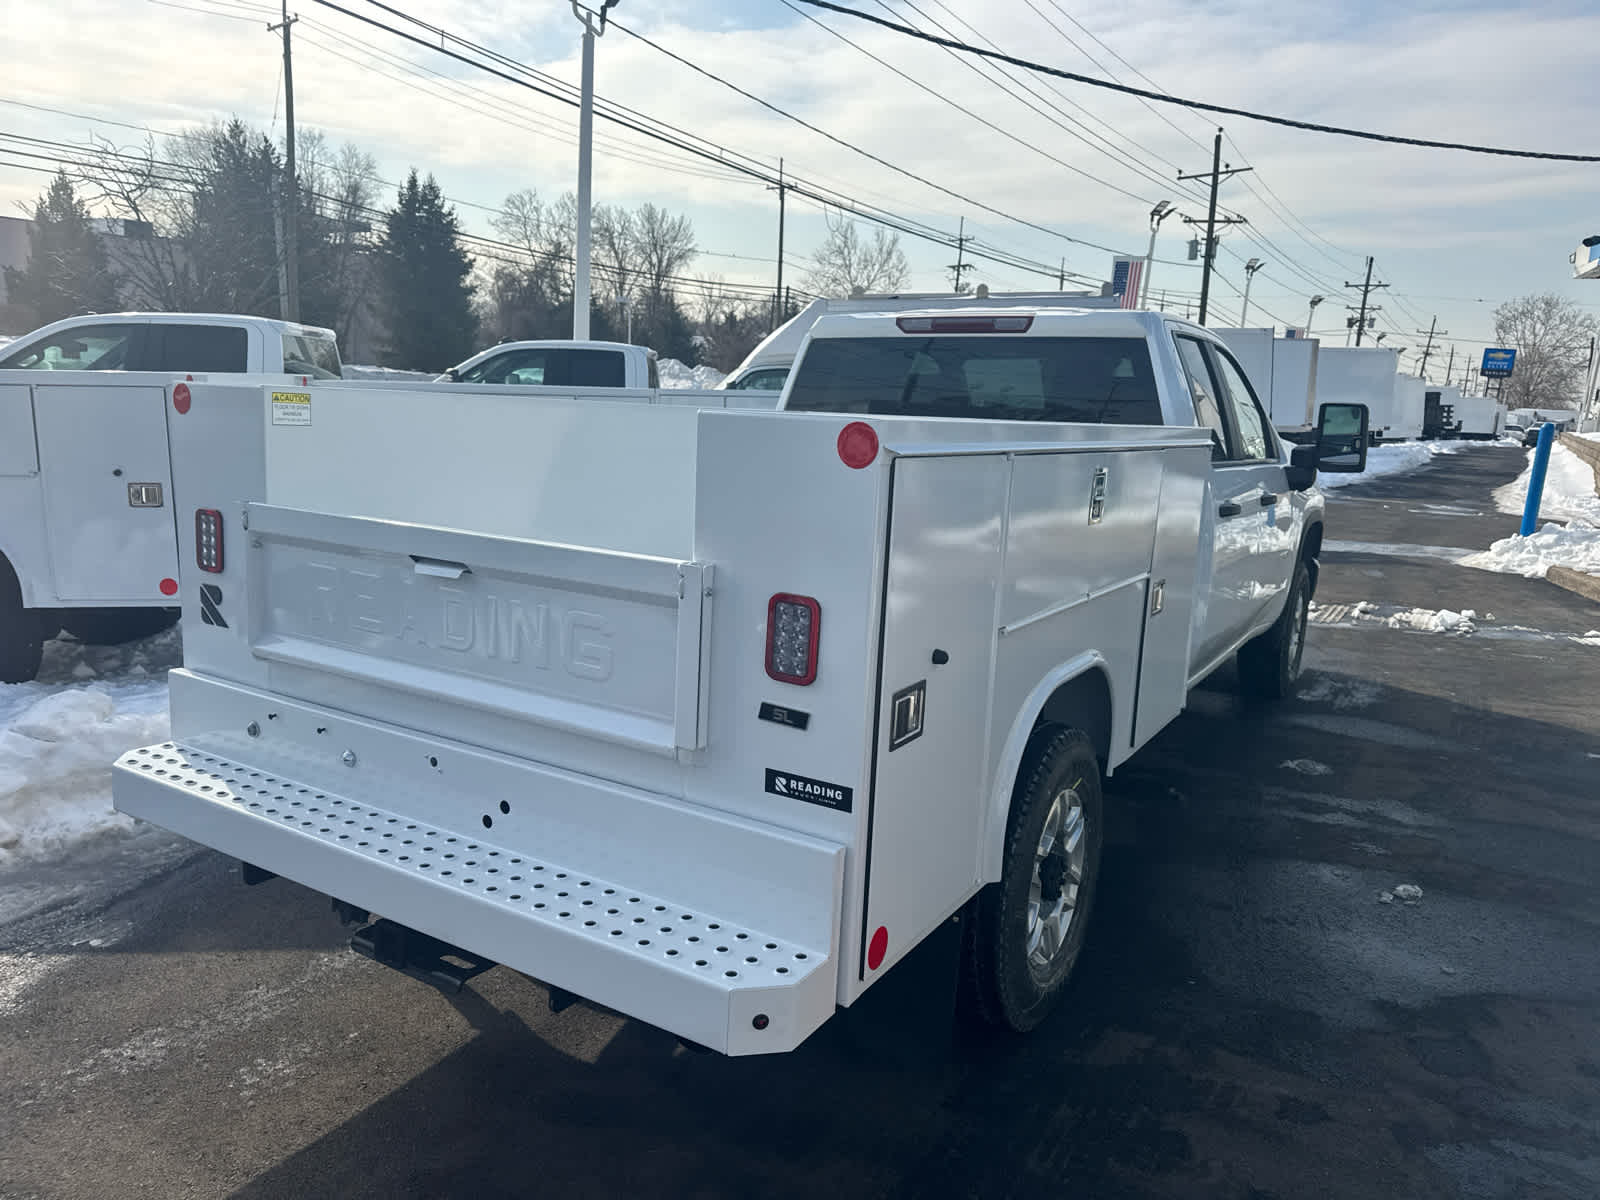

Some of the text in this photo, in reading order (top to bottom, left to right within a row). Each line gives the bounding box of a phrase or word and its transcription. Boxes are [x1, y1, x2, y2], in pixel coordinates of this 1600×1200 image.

[280, 394, 310, 403] CAUTION
[306, 560, 616, 682] READING
[790, 780, 843, 800] READING
